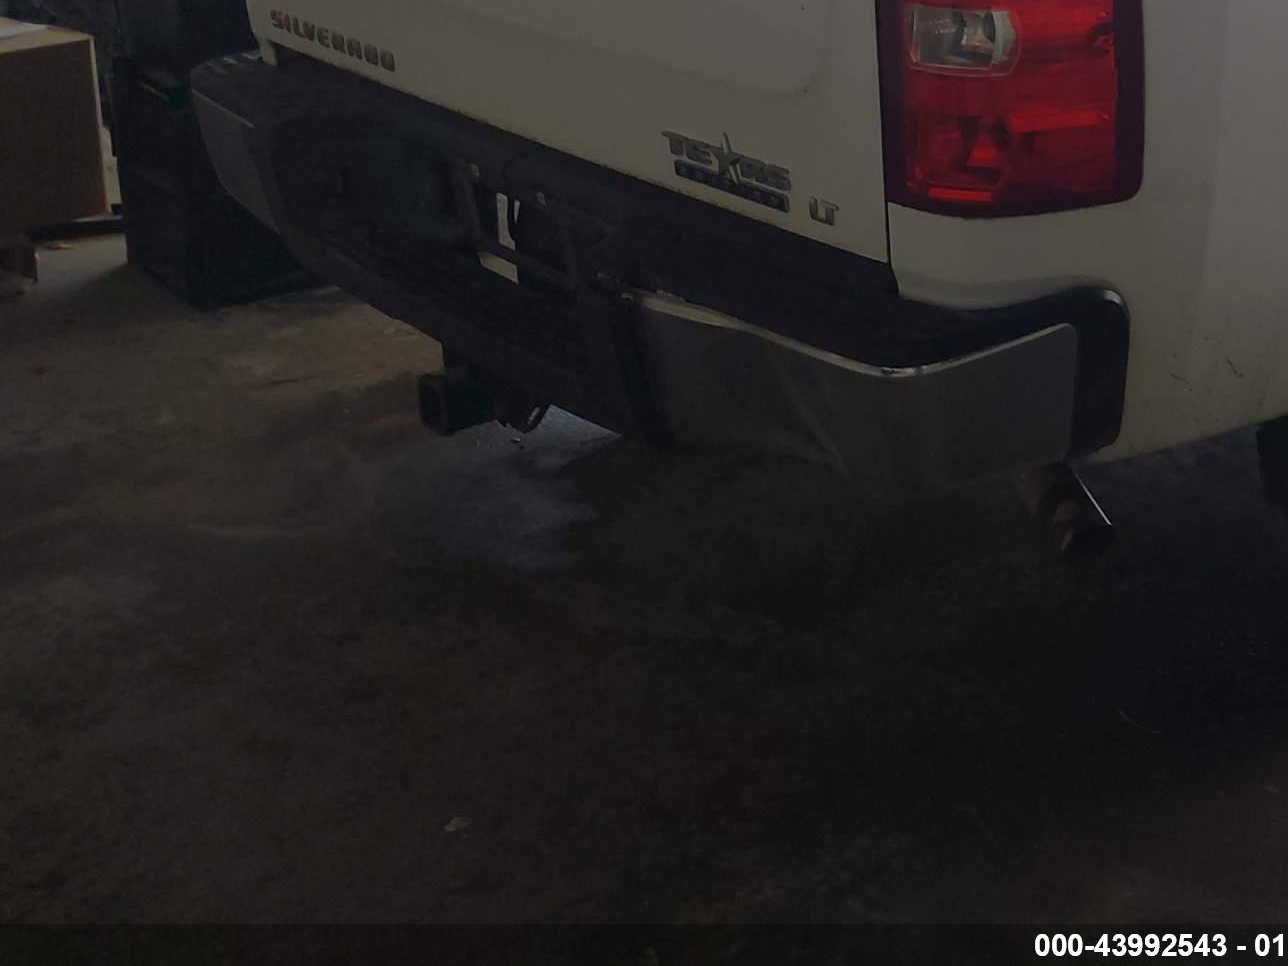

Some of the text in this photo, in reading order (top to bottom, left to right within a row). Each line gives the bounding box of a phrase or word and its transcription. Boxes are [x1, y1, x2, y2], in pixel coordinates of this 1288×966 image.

[270, 9, 396, 72] SILVERADO
[661, 130, 792, 191] TEXAS
[808, 196, 840, 227] LT
